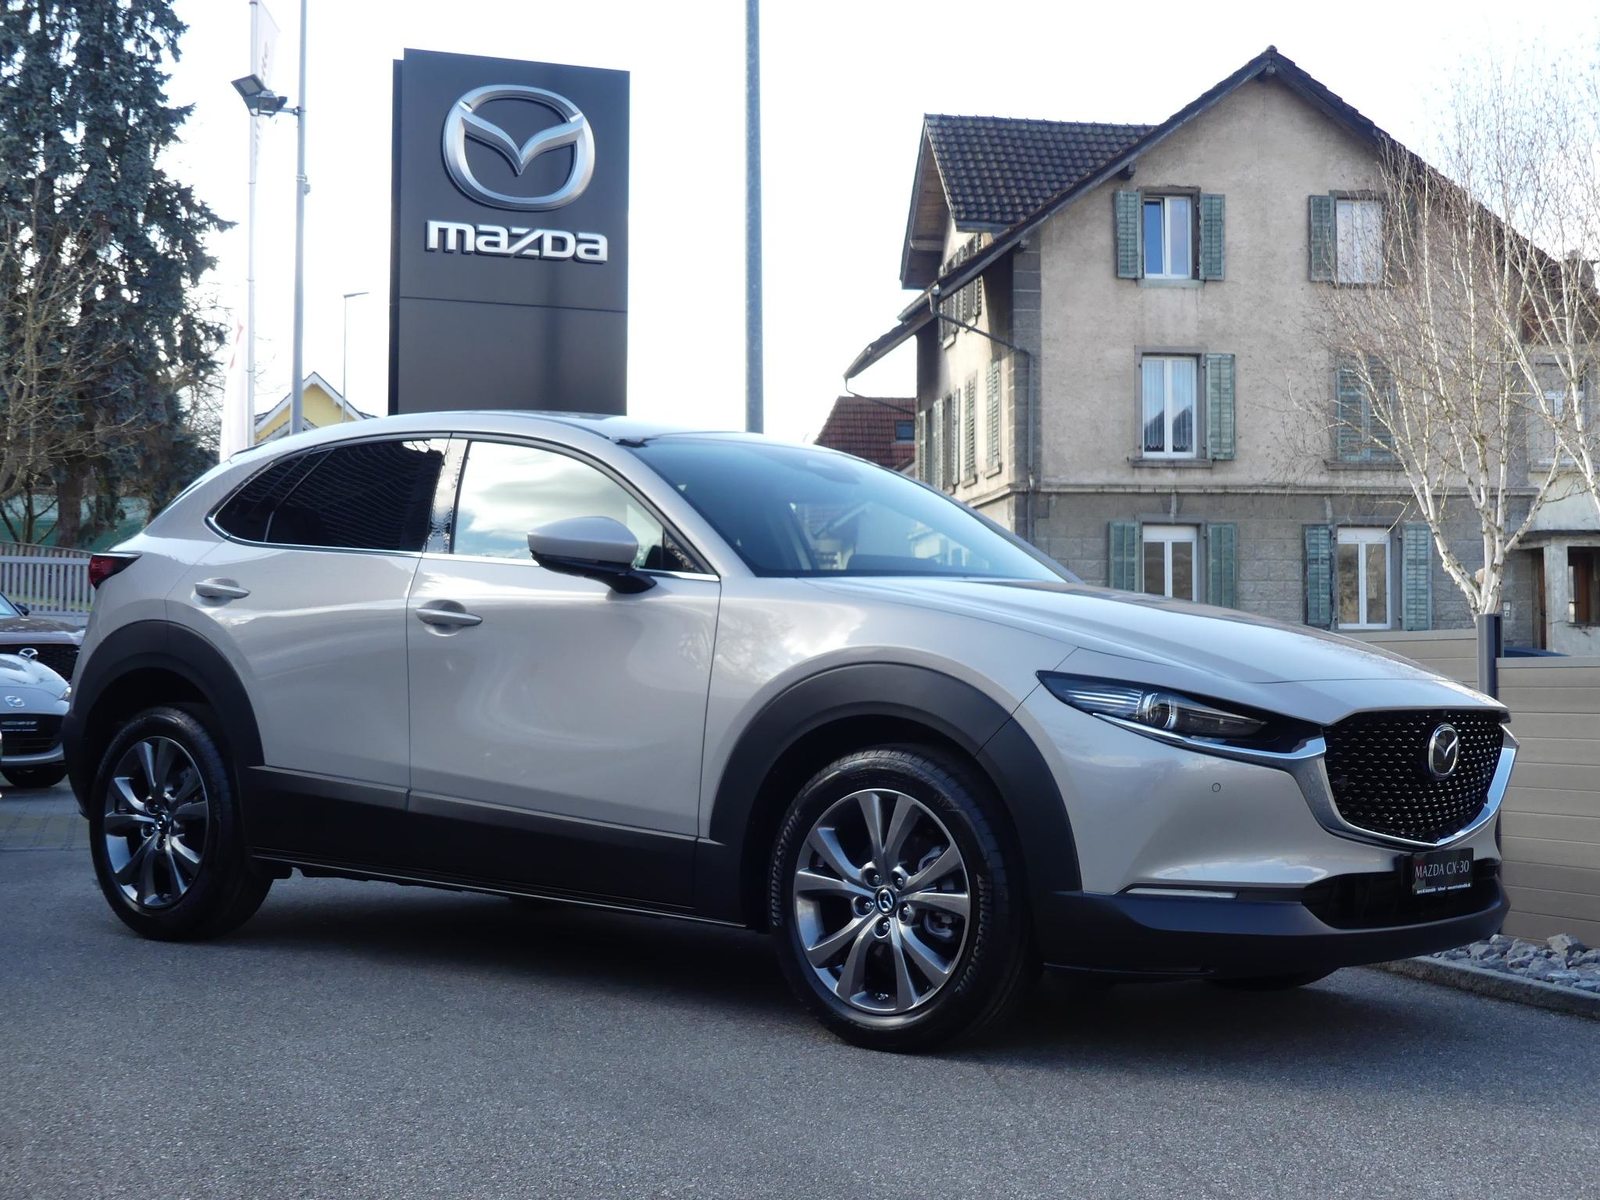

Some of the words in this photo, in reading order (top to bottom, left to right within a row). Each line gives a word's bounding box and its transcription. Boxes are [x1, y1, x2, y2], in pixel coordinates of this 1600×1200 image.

[426, 220, 608, 263] mazda
[1414, 863, 1444, 878] MAZDA
[1446, 860, 1470, 875] CX-30
